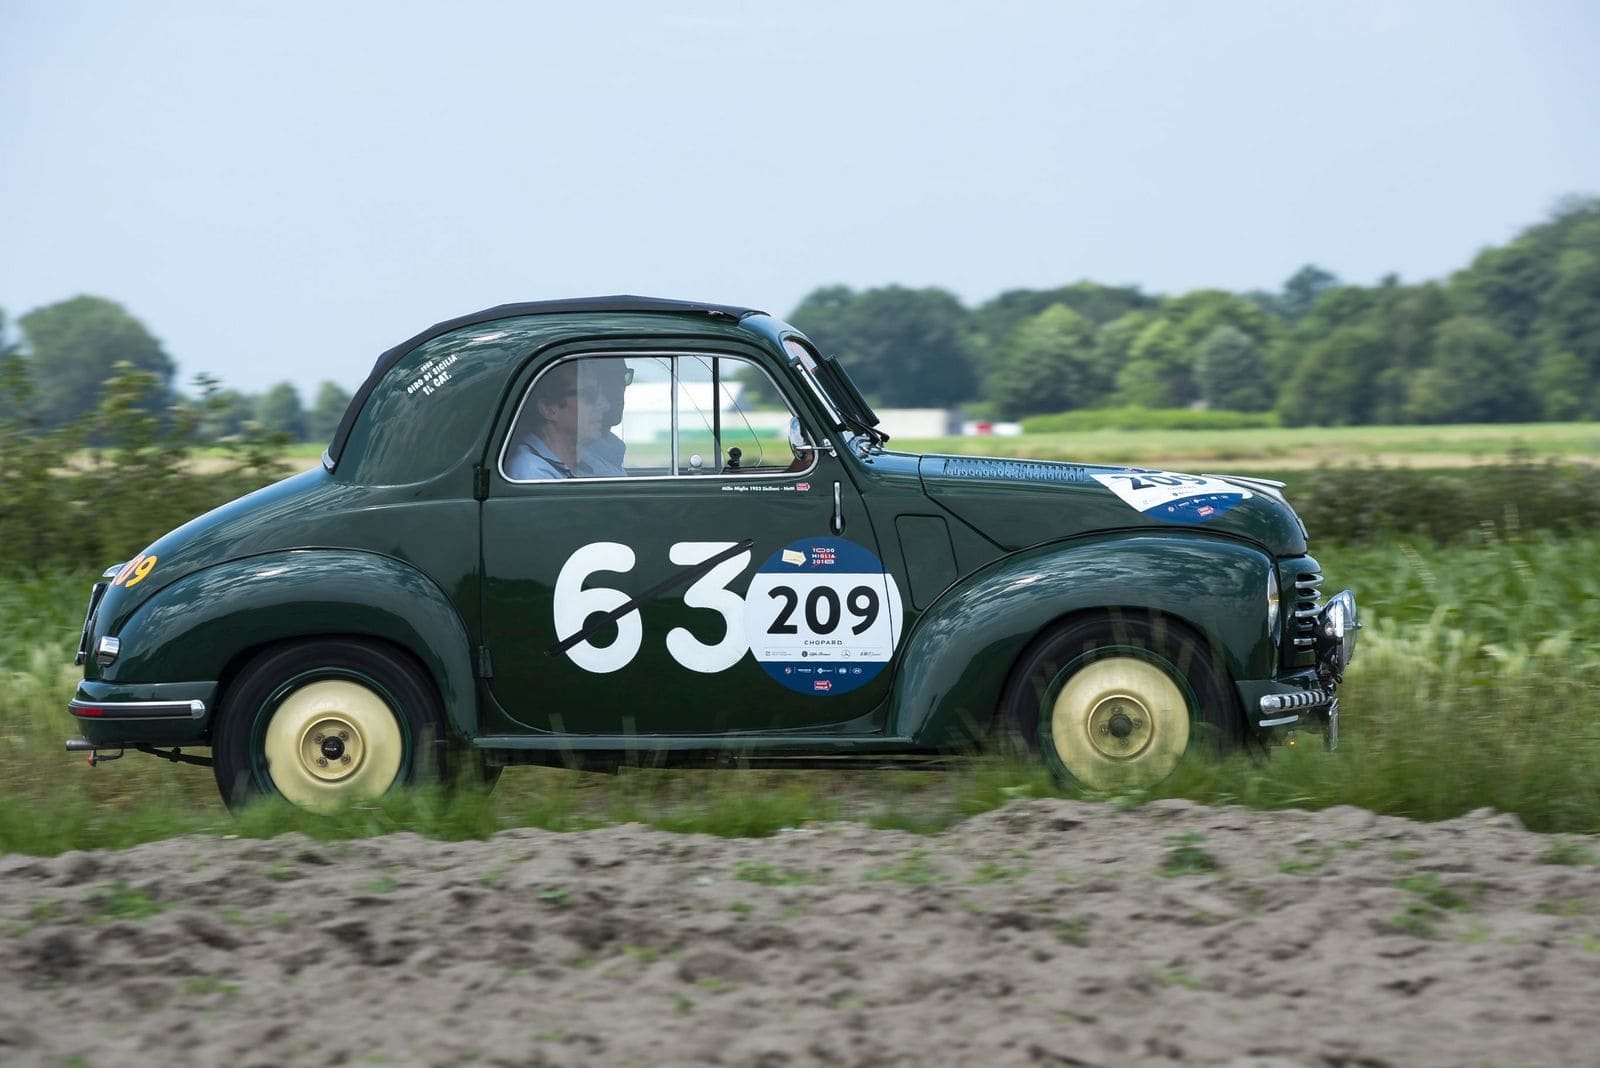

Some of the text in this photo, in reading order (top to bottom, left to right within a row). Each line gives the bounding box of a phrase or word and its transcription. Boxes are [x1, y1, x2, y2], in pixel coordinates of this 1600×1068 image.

[407, 354, 458, 394] GIRO DI SICILIA
[433, 371, 452, 387] CAT.
[1110, 475, 1208, 491] 209
[766, 585, 880, 636] 209
